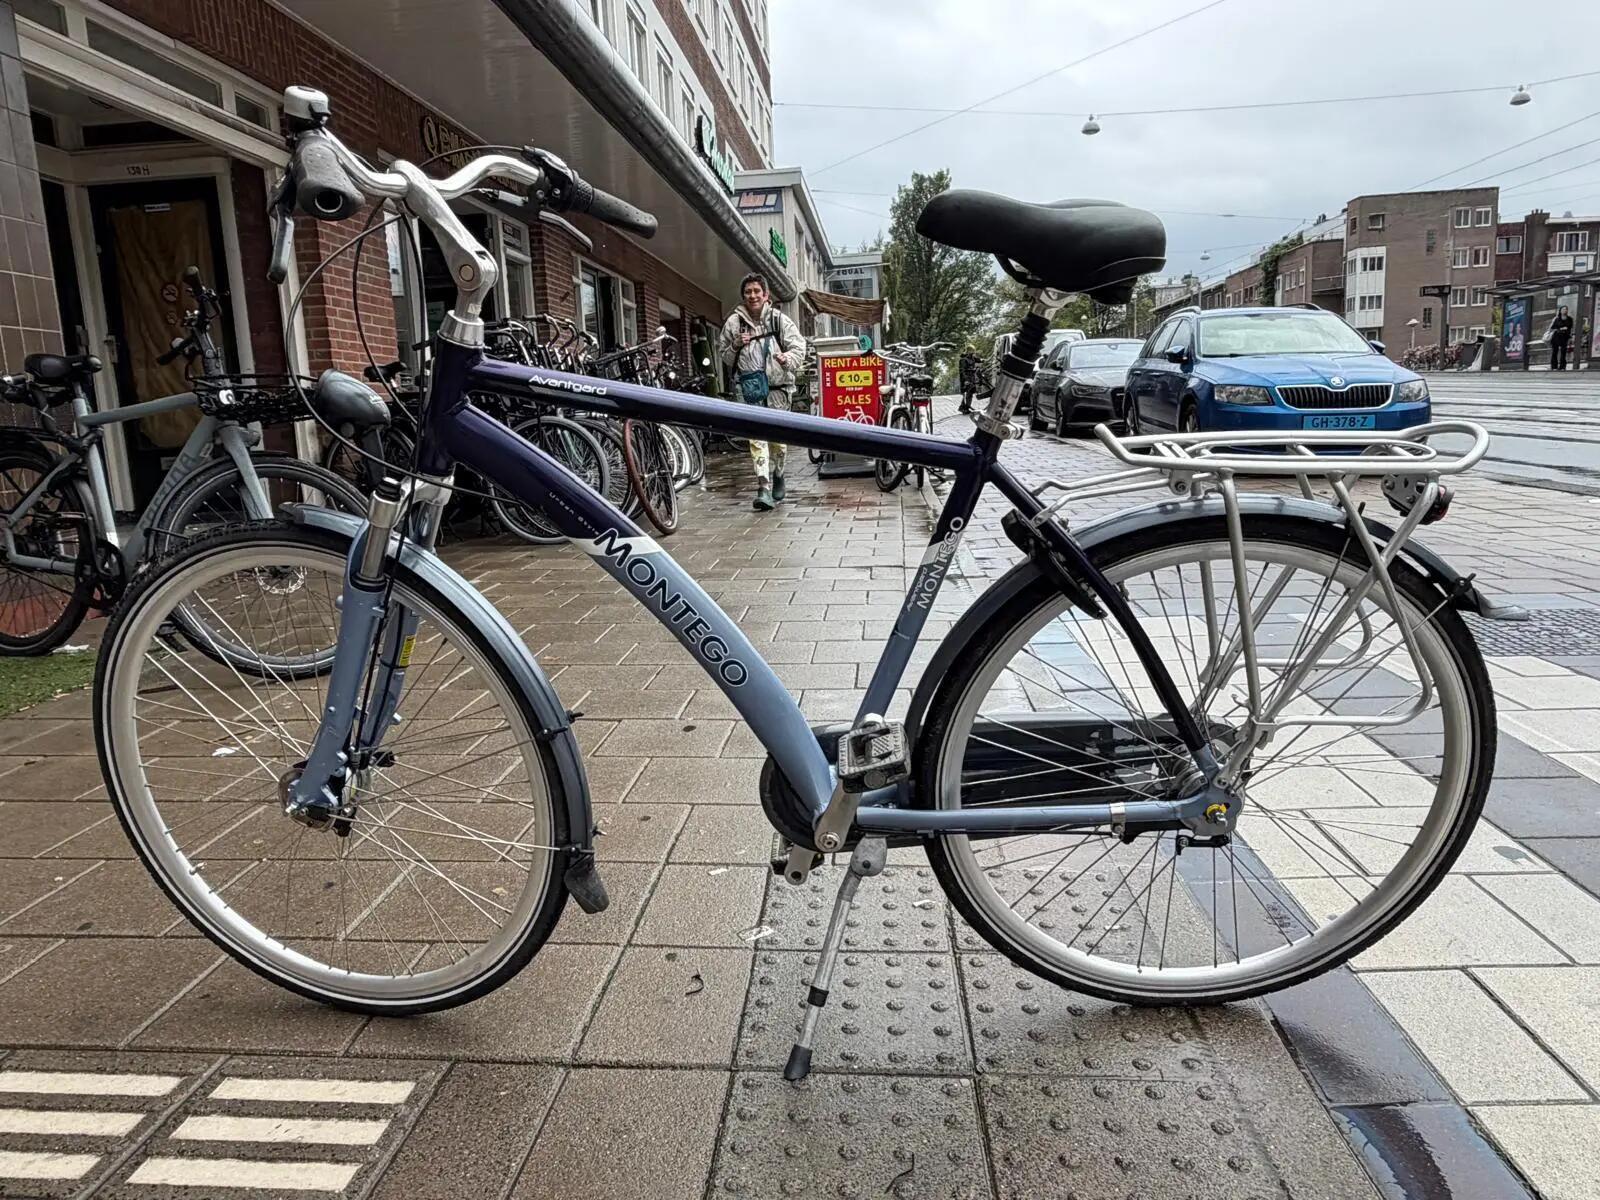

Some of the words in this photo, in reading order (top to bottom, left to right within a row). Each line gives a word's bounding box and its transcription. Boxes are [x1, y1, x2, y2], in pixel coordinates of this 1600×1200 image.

[824, 358, 851, 368] RENT
[860, 356, 883, 367] BIKE
[528, 374, 607, 395] Avantgard
[837, 394, 871, 405] SALES
[1311, 416, 1369, 428] GH-378-Z
[916, 516, 964, 609] MONTEGO
[593, 527, 749, 688] MONTEGO
